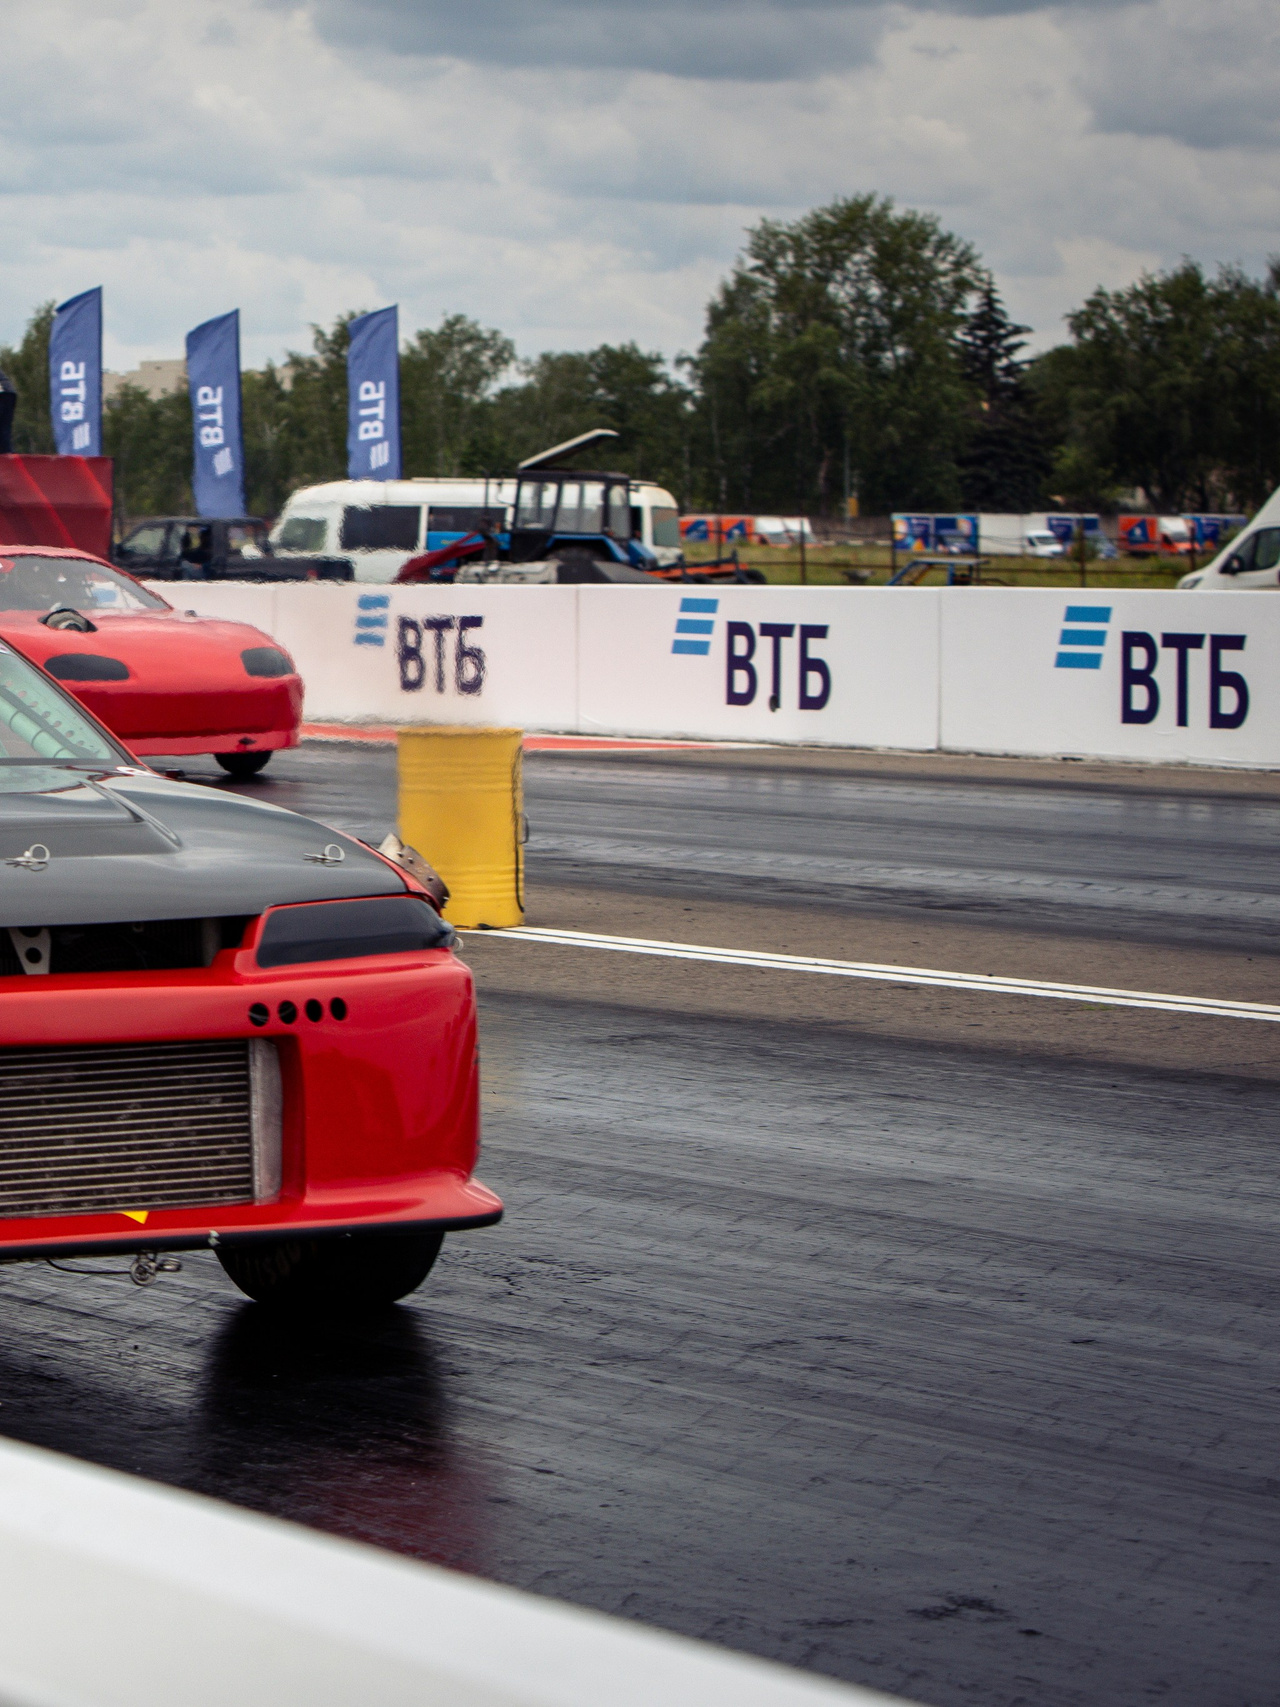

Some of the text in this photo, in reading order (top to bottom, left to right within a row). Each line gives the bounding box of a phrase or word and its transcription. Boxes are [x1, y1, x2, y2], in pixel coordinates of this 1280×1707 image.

[397, 615, 487, 696] ВТБ
[725, 620, 832, 711] ВТБ
[1121, 630, 1250, 729] ВТБ
